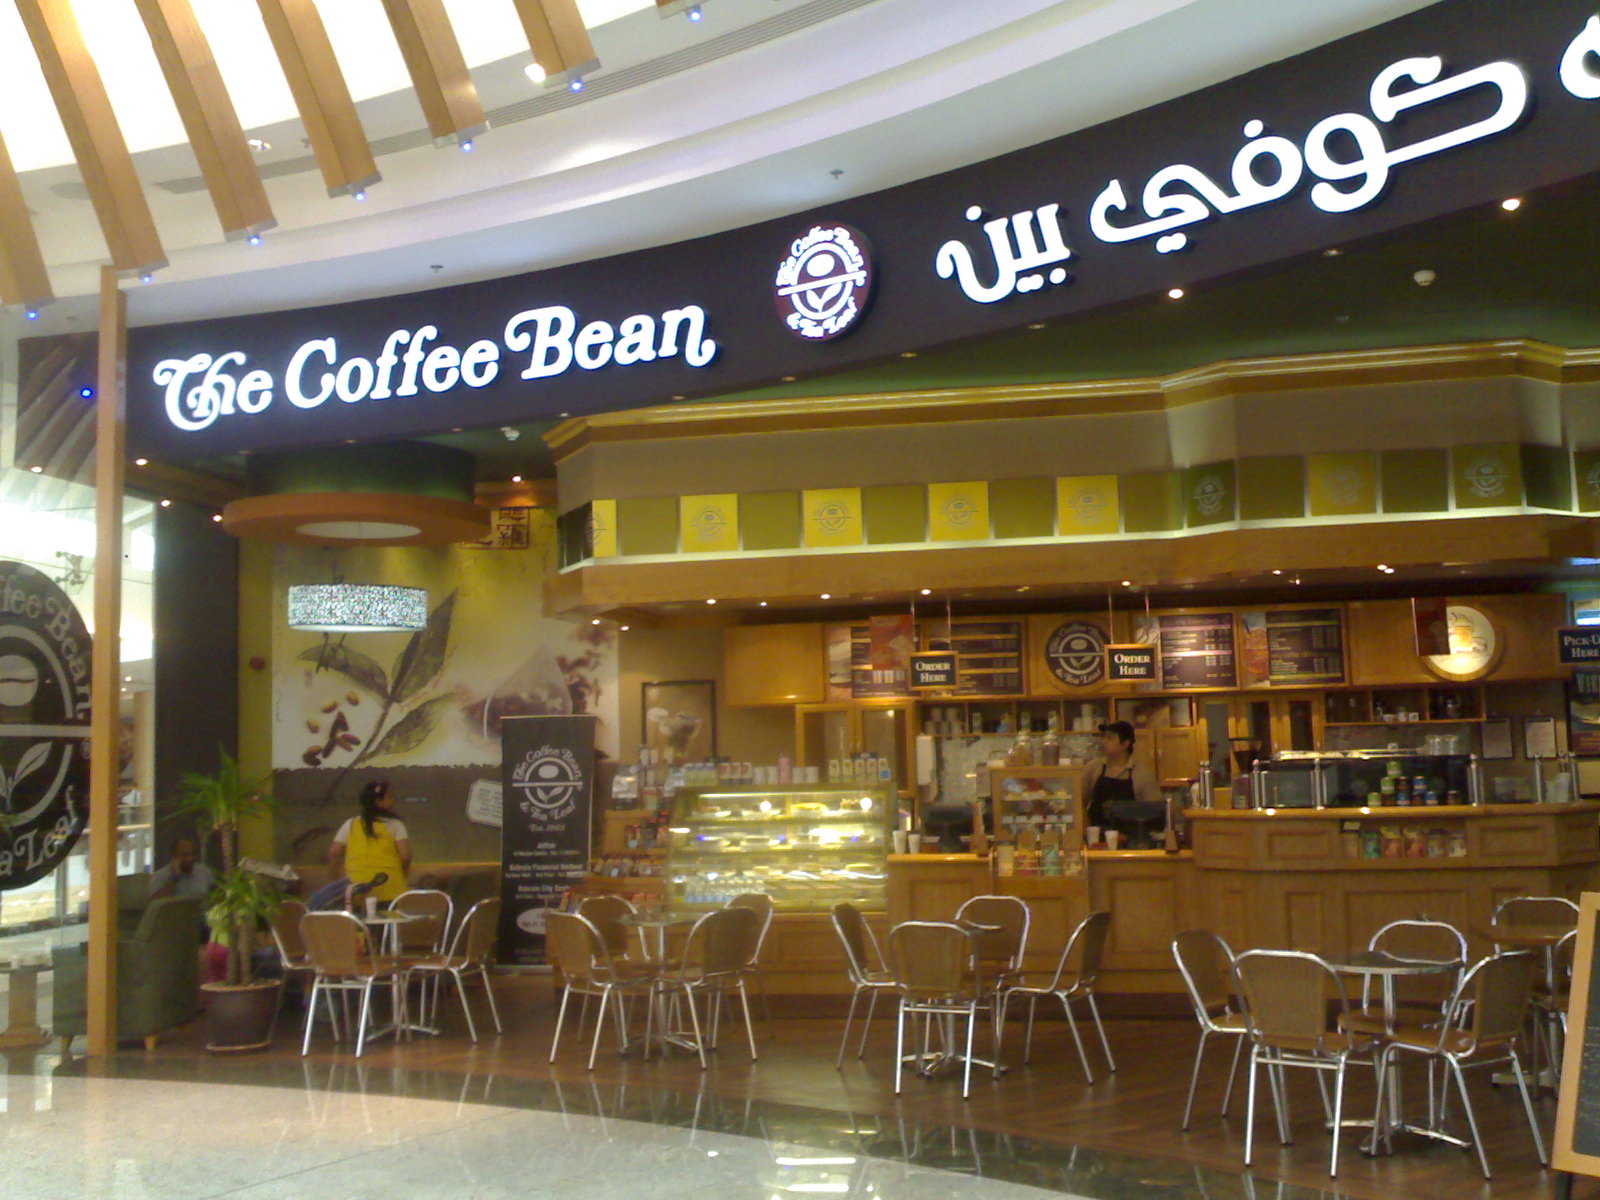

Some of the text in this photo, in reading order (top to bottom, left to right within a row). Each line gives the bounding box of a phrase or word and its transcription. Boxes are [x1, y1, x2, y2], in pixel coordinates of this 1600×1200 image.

[1090, 55, 1527, 253] كوفي
[936, 204, 1071, 303] بين
[152, 305, 716, 431] The Coffee Bean
[1563, 633, 1600, 646] PICK-U
[1113, 653, 1151, 663] ORDER
[915, 661, 951, 671] ORDER
[1119, 665, 1147, 675] HERE
[920, 672, 947, 682] HERE
